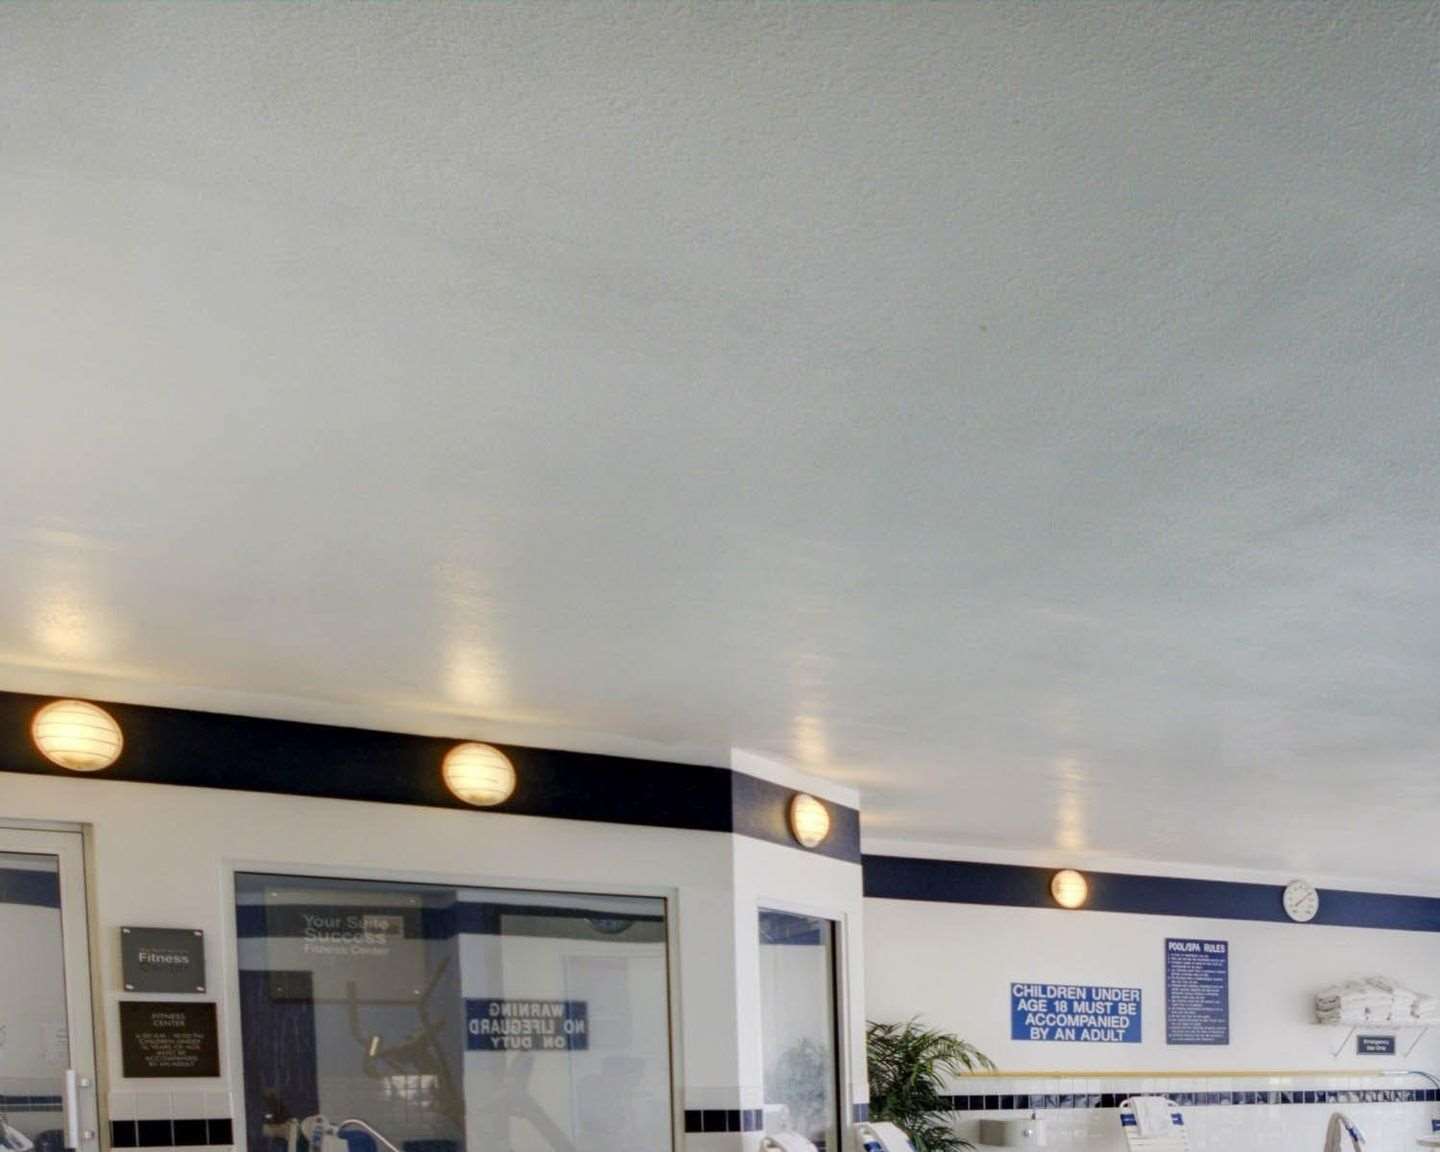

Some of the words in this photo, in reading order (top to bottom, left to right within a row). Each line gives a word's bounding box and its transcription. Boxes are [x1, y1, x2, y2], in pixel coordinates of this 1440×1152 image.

[303, 912, 341, 928] Your
[1203, 943, 1226, 953] RULES
[138, 952, 190, 964] Fitness
[1012, 984, 1087, 999] CHILDREN
[1091, 987, 1141, 1002] UNDER
[1017, 998, 1048, 1012] AGE
[1054, 1000, 1068, 1013] 18
[1073, 1001, 1113, 1014] MUST
[1118, 1003, 1137, 1015] BE
[1025, 1013, 1130, 1029] ACCOMPANIED
[1030, 1027, 1050, 1040] BY
[1054, 1028, 1076, 1041] AN
[1080, 1028, 1126, 1041] ADULT
